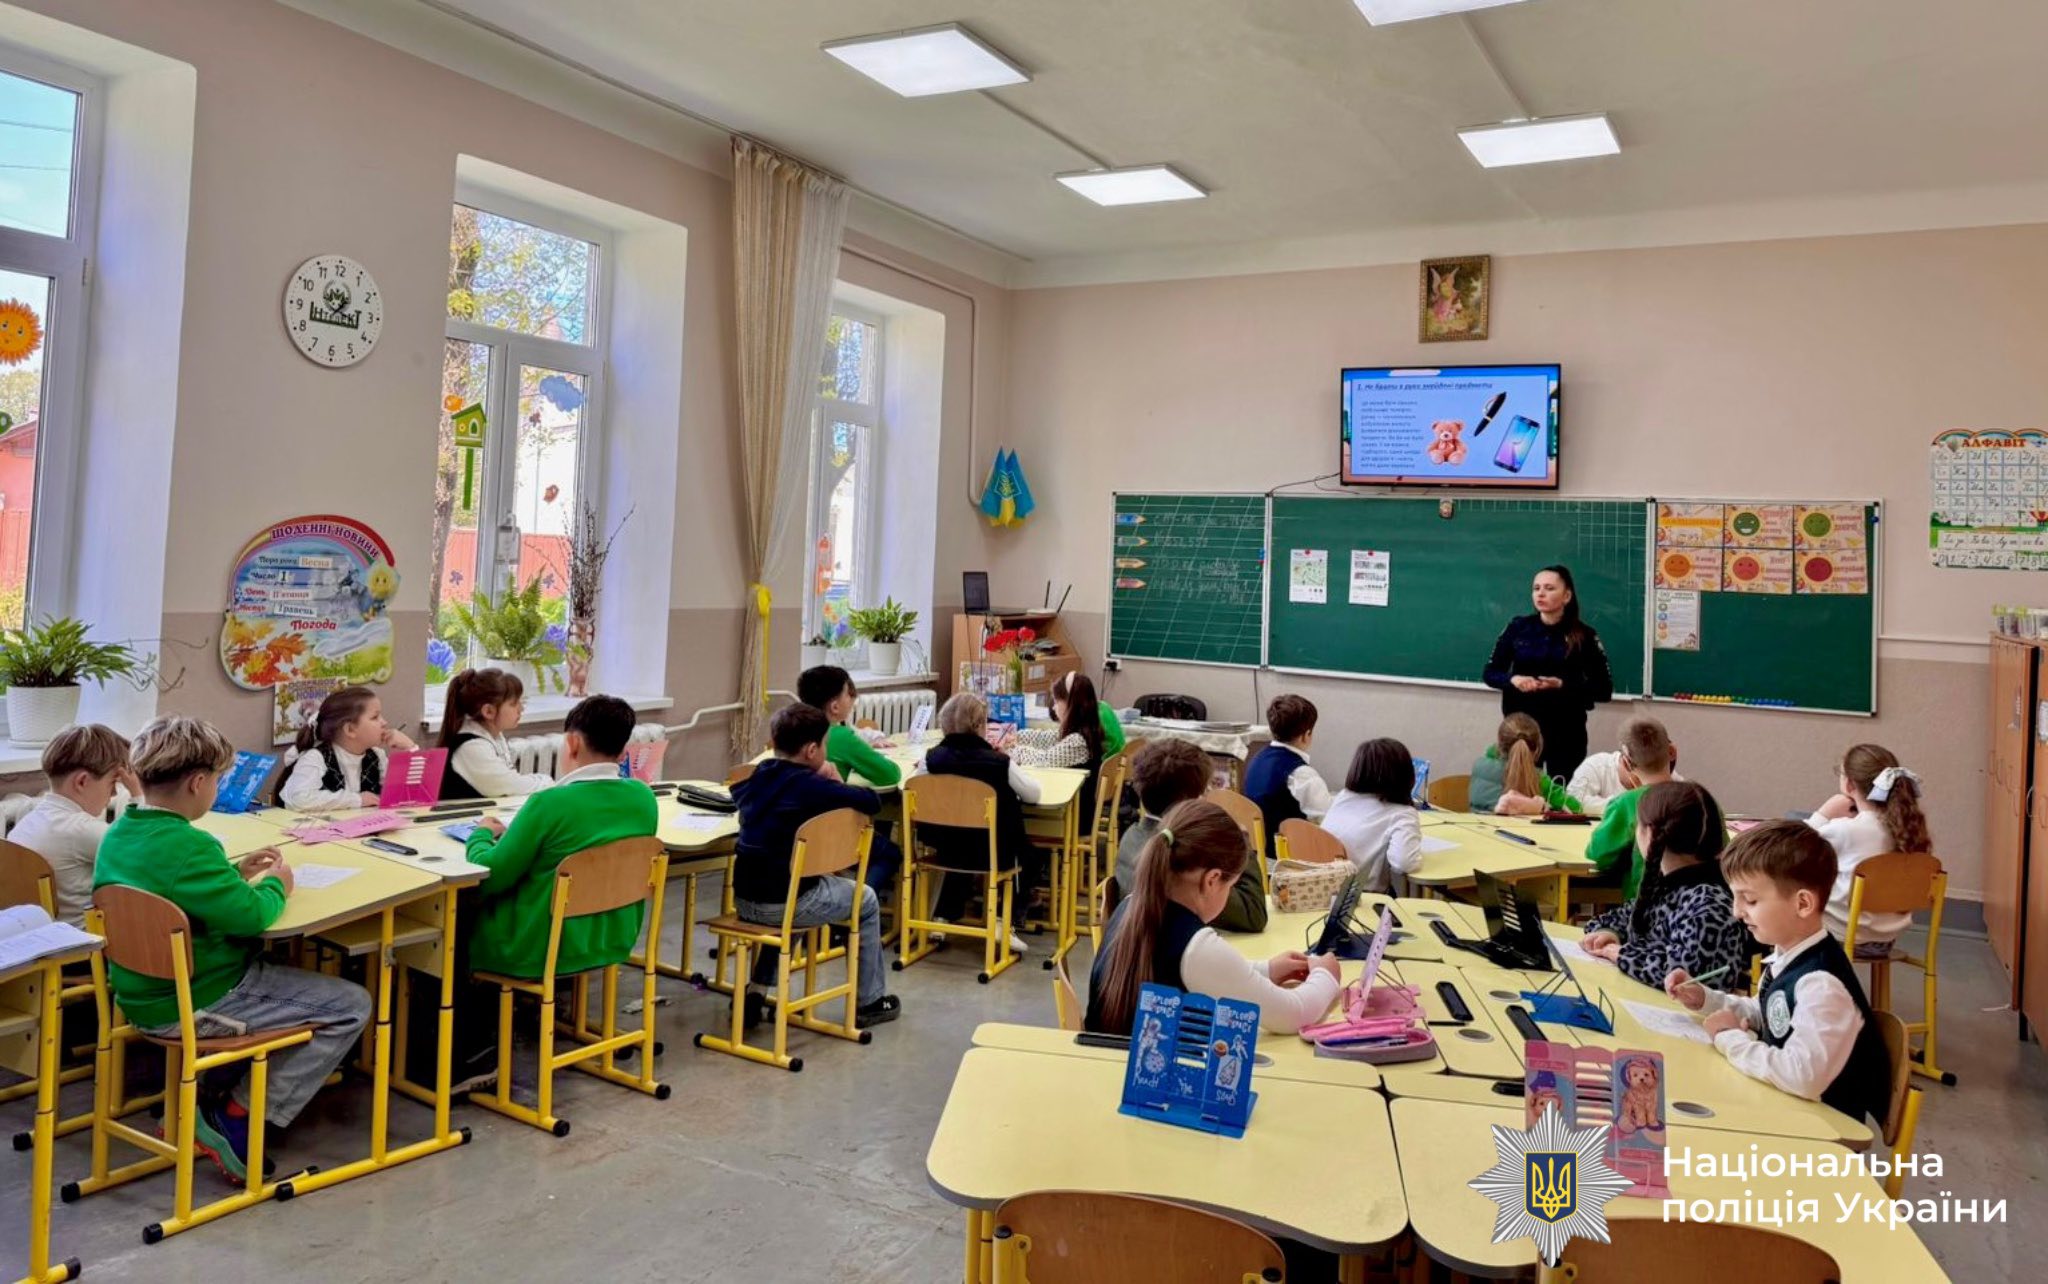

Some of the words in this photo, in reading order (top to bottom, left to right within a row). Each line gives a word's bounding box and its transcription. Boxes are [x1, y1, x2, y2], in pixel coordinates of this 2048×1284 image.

[319, 267, 327, 279] 11
[335, 265, 346, 277] 12
[303, 279, 314, 291] 10
[356, 276, 360, 287] 1
[365, 292, 371, 303] 2
[296, 298, 303, 310] 9
[367, 312, 373, 323] 3
[299, 320, 306, 331] 8
[361, 332, 366, 341] 4
[312, 337, 318, 348] 7
[328, 345, 335, 356] 6
[347, 343, 353, 354] 5
[1961, 438, 2026, 448] АЛФАВІТ
[271, 523, 331, 538] ЩОДЕННІ
[335, 526, 378, 558] НОВИНИ
[302, 557, 329, 566] Весна
[250, 571, 276, 580] Число
[278, 604, 314, 615] Травень
[290, 618, 337, 630] Погода
